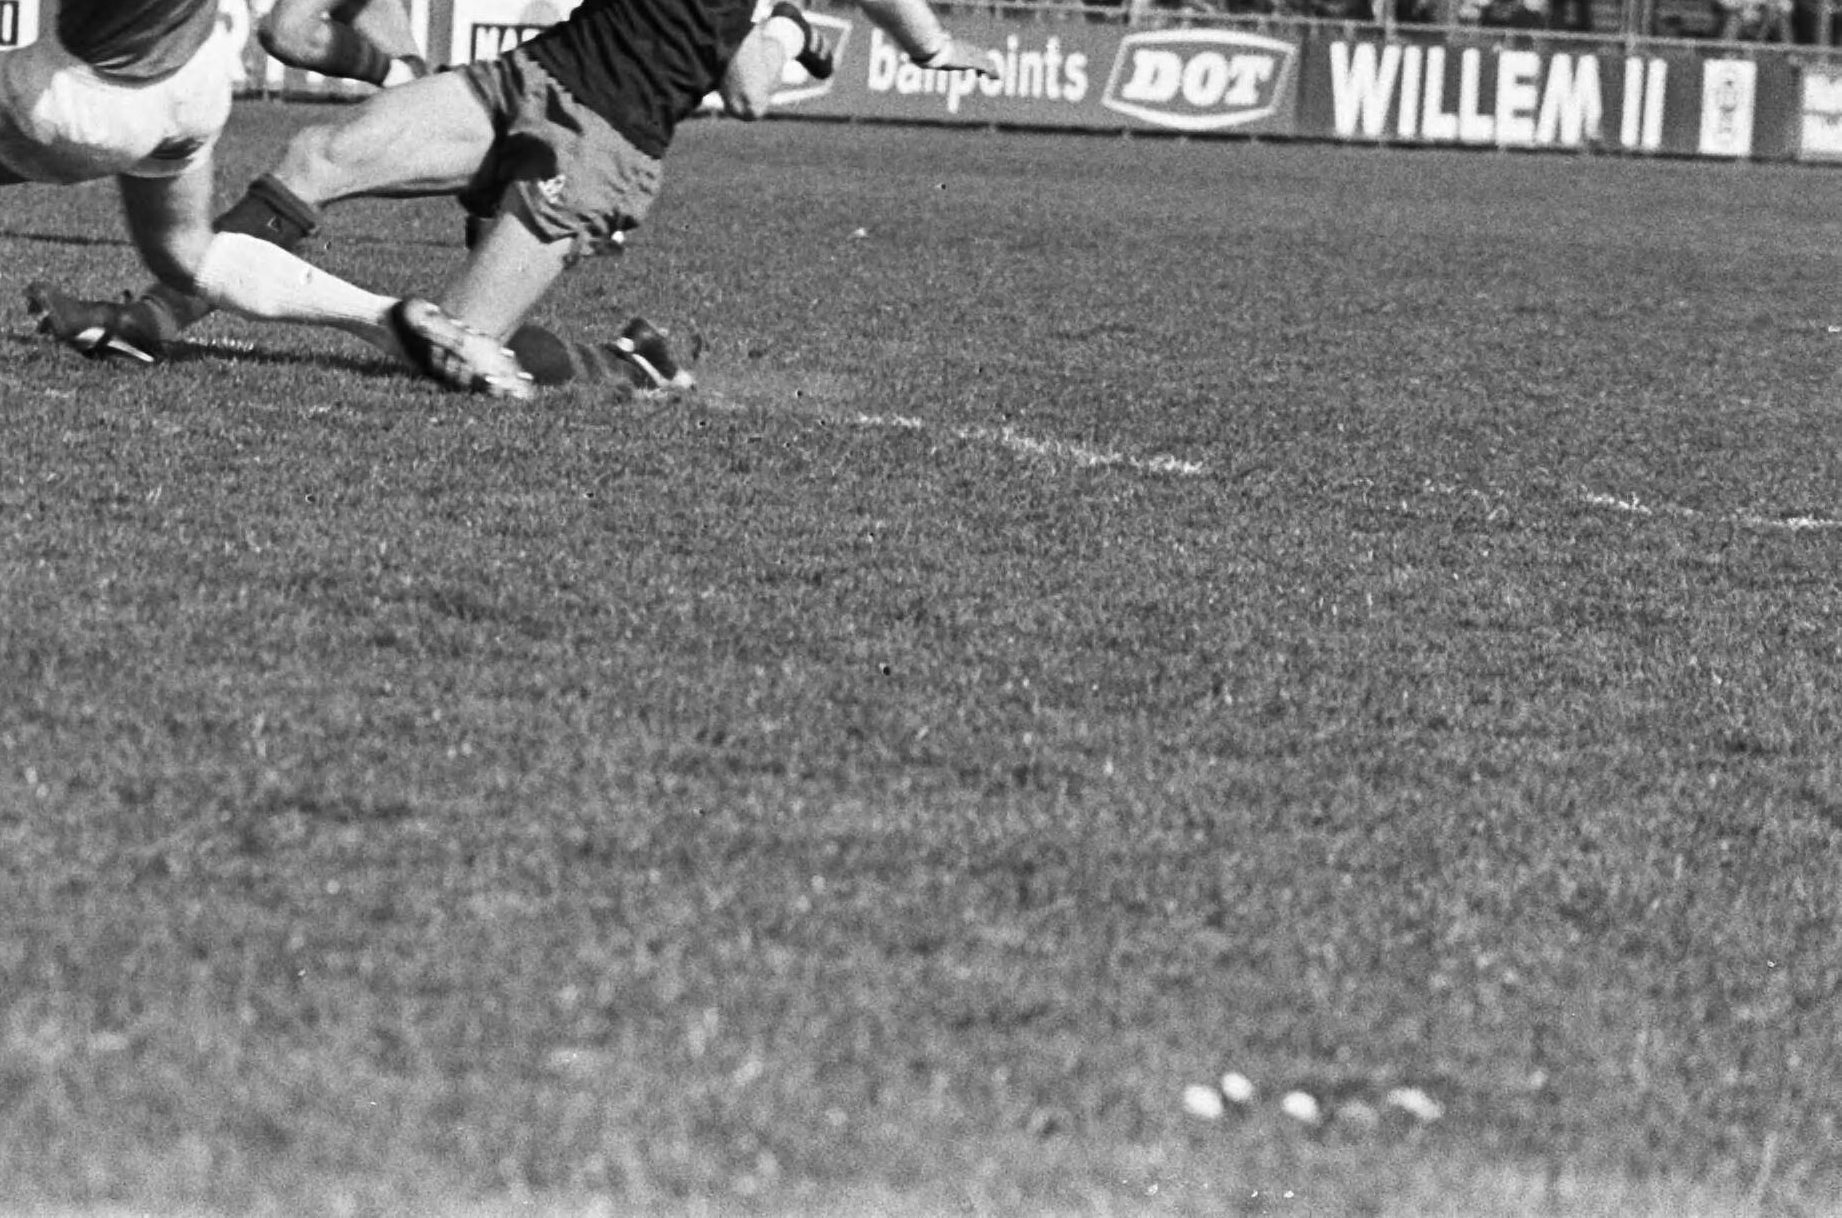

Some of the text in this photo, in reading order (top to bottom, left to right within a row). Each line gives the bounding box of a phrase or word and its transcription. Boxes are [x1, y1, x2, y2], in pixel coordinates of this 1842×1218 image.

[1121, 48, 1276, 107] DOT
[1330, 40, 1668, 151] WILLEM II
